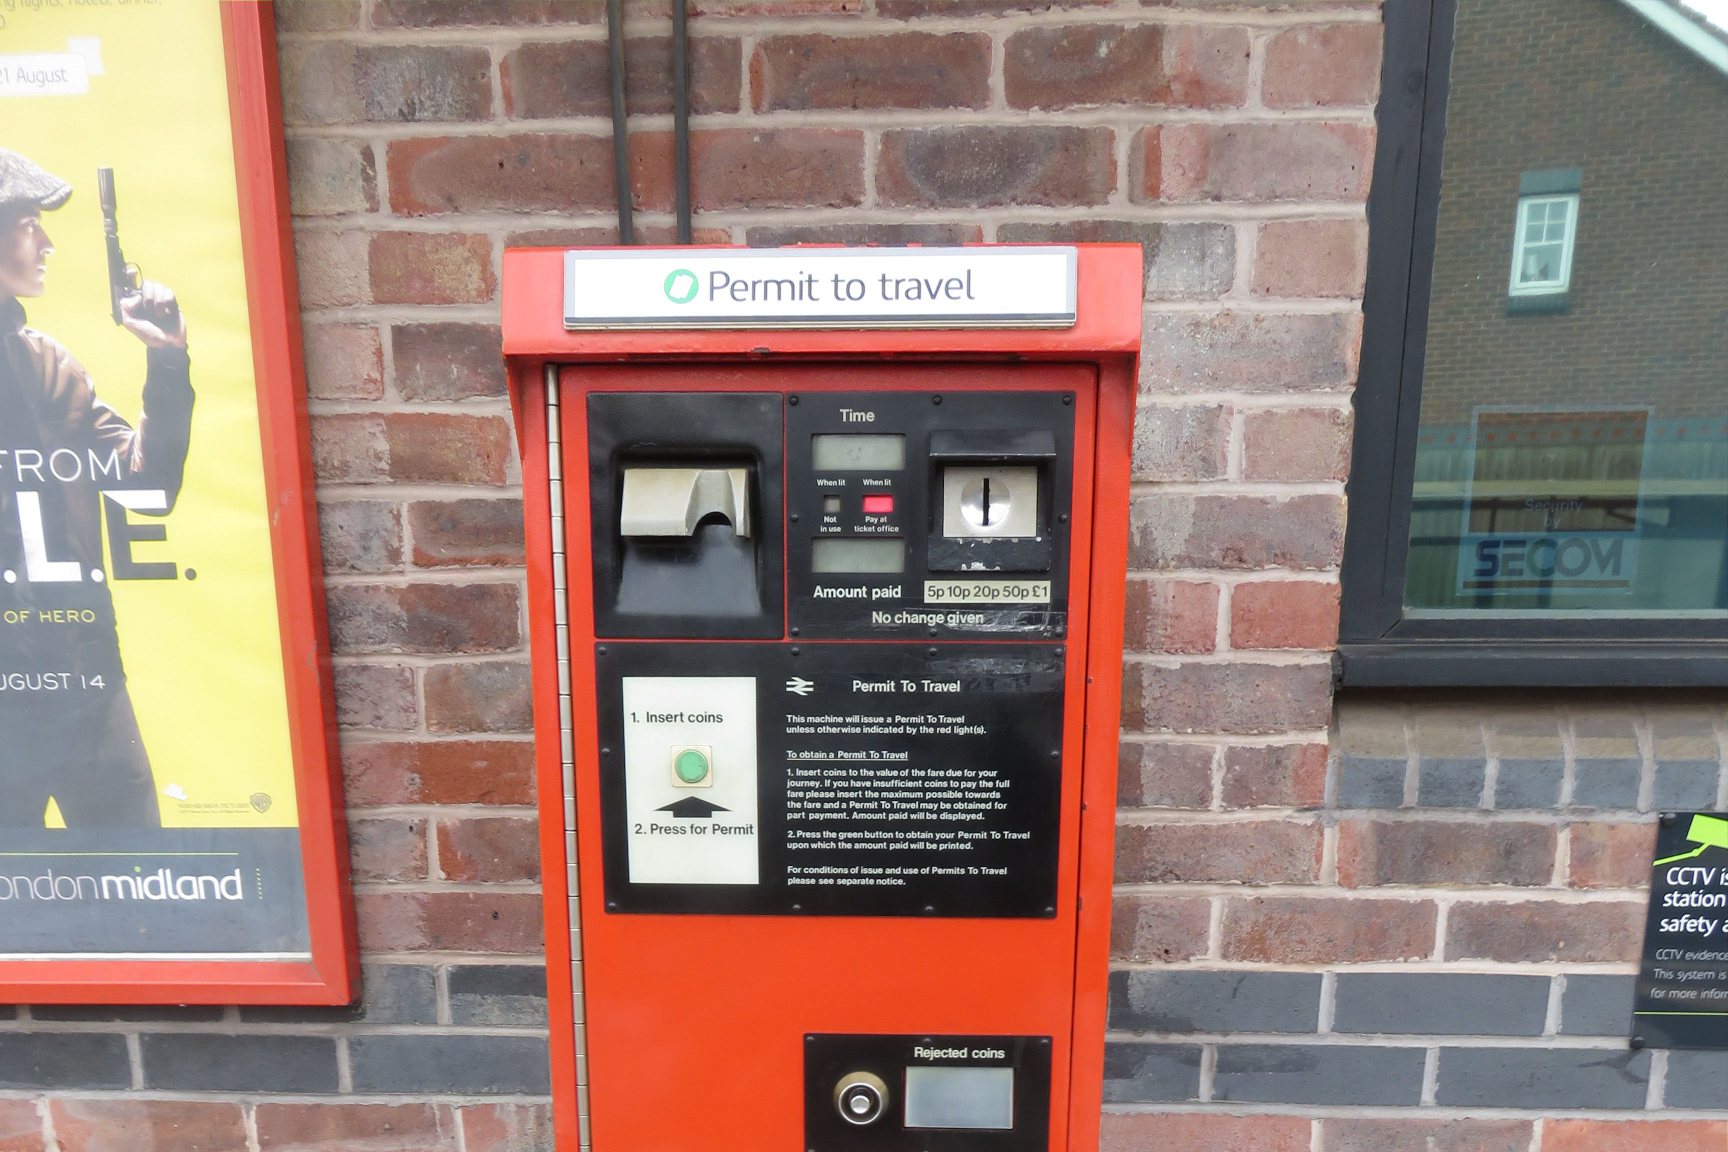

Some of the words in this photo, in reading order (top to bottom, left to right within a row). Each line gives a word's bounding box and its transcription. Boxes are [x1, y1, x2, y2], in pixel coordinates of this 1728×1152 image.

[17, 67, 69, 88] August
[709, 270, 819, 302] Permit
[832, 274, 866, 301] to
[878, 269, 975, 301] travel
[839, 409, 875, 422] Time
[816, 479, 838, 487] When
[838, 479, 846, 487] lit
[862, 479, 883, 487] When
[1526, 498, 1584, 514] Security
[865, 516, 878, 524] Pay
[1544, 513, 1560, 529] by
[820, 525, 827, 533] in
[854, 525, 875, 533] ticket
[877, 525, 899, 533] office
[1474, 538, 1623, 578] SECOM
[813, 585, 867, 599] Amount
[872, 585, 902, 600] paid
[927, 586, 945, 600] 5p
[947, 586, 970, 600] 10p
[973, 586, 1000, 600] 20p
[1002, 586, 1029, 600] 50p
[1032, 586, 1048, 598] £1
[4, 610, 30, 624] OF
[40, 610, 96, 624] HERO
[872, 611, 892, 624] No
[894, 611, 945, 626] change
[947, 612, 984, 626] given
[81, 675, 105, 690] 14
[853, 680, 895, 692] Permit
[900, 680, 916, 692] To
[921, 680, 960, 692] Travel
[631, 712, 640, 723] 1.
[646, 712, 685, 723] Insert
[688, 712, 724, 723] coins
[786, 714, 805, 724] This
[807, 714, 843, 724] machine
[845, 714, 860, 724] will
[861, 714, 884, 724] issue
[895, 714, 925, 724] Permit
[927, 714, 938, 724] To
[938, 714, 965, 724] Travel
[786, 725, 815, 734] unless
[817, 725, 861, 734] otherwise
[863, 725, 904, 734] indicated
[906, 725, 917, 735] by
[920, 725, 934, 734] the
[937, 725, 951, 734] red
[954, 725, 987, 736] light(s).
[786, 750, 797, 759] To
[799, 750, 827, 759] obtain
[837, 750, 866, 759] Permit
[869, 750, 880, 759] To
[882, 750, 908, 759] Travel
[786, 768, 794, 777] 1.
[796, 768, 821, 777] Insert
[823, 768, 847, 777] coins
[849, 768, 858, 777] to
[860, 768, 874, 777] the
[876, 768, 898, 777] value
[911, 768, 926, 777] the
[927, 768, 945, 777] fare
[946, 768, 962, 777] due
[964, 768, 976, 777] for
[978, 770, 998, 779] your
[786, 779, 822, 788] journey.
[824, 779, 831, 788] If
[850, 779, 871, 788] have
[873, 779, 922, 788] insufficient
[924, 779, 948, 788] coins
[979, 779, 993, 788] the
[995, 779, 1010, 788] full
[787, 790, 804, 799] fare
[806, 790, 835, 799] please
[837, 790, 862, 799] insert
[865, 790, 879, 799] the
[881, 790, 923, 799] maximum
[926, 791, 963, 800] possible
[965, 790, 1001, 799] towards
[787, 801, 801, 809] the
[803, 801, 821, 809] fare
[823, 801, 840, 809] and
[849, 801, 878, 809] Permit
[880, 801, 891, 809] To
[892, 801, 918, 809] Travel
[920, 803, 939, 811] may
[953, 801, 992, 809] obtained
[994, 801, 1008, 809] for
[786, 812, 805, 820] part
[808, 812, 850, 821] payment.
[852, 812, 887, 820] Amount
[888, 812, 908, 821] paid
[910, 812, 924, 820] will
[940, 812, 986, 821] displayed.
[635, 823, 647, 835] 2.
[650, 823, 687, 835] Press
[690, 823, 708, 835] for
[712, 823, 754, 835] Permit
[787, 830, 796, 839] 2.
[797, 830, 821, 839] Press
[823, 830, 837, 839] the
[838, 832, 863, 840] green
[864, 830, 894, 839] button
[906, 830, 934, 839] obtain
[957, 830, 987, 839] Permit
[989, 830, 1001, 839] To
[1002, 830, 1031, 839] Travel
[810, 842, 836, 850] which
[838, 842, 853, 850] the
[854, 842, 887, 850] amount
[889, 842, 909, 851] paid
[910, 842, 925, 850] will
[939, 842, 974, 851] printed.
[787, 866, 801, 875] For
[803, 866, 849, 875] conditions
[860, 866, 883, 875] issue
[885, 866, 901, 875] and
[932, 866, 966, 875] Permits
[968, 866, 979, 875] To
[980, 866, 1008, 875] Travel
[787, 877, 816, 886] please
[837, 877, 875, 886] separate
[876, 877, 906, 886] notice.
[1666, 867, 1716, 886] CCTV
[1663, 890, 1726, 907] station
[1659, 914, 1718, 937] safety
[1656, 949, 1683, 960] CCTV
[1653, 968, 1674, 980] This
[1677, 970, 1715, 982] system
[1718, 970, 1727, 980] is
[1650, 988, 1666, 999] for
[1668, 990, 1698, 999] more
[914, 1047, 968, 1061] Rejected
[971, 1048, 1005, 1059] coins
